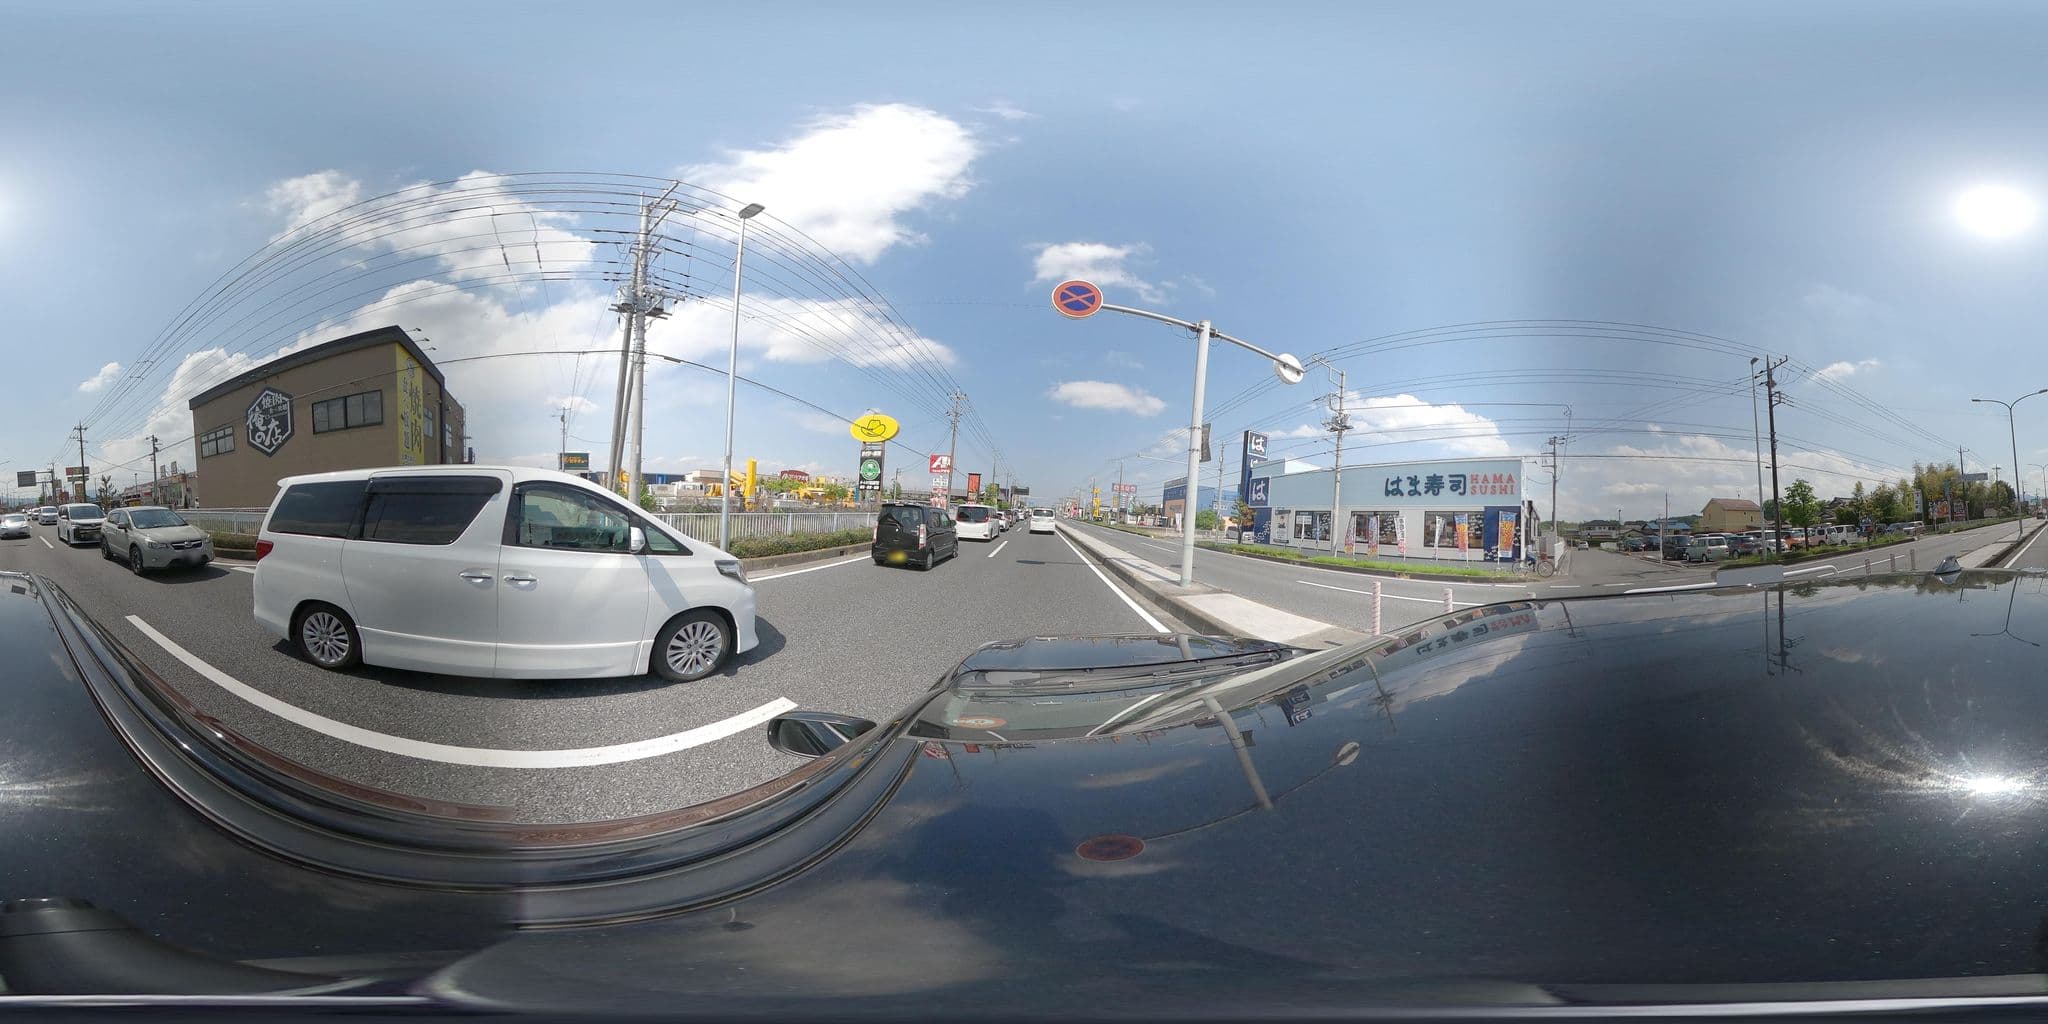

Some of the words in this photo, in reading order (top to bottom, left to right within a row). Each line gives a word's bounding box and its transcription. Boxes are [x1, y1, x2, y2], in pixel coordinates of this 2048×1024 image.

[409, 382, 422, 454] 焼肉
[1251, 435, 1265, 451] は
[1384, 473, 1467, 497] はま寿司
[1470, 473, 1515, 484] HAMA
[1252, 482, 1265, 502] は
[1470, 484, 1515, 496] SUSHI
